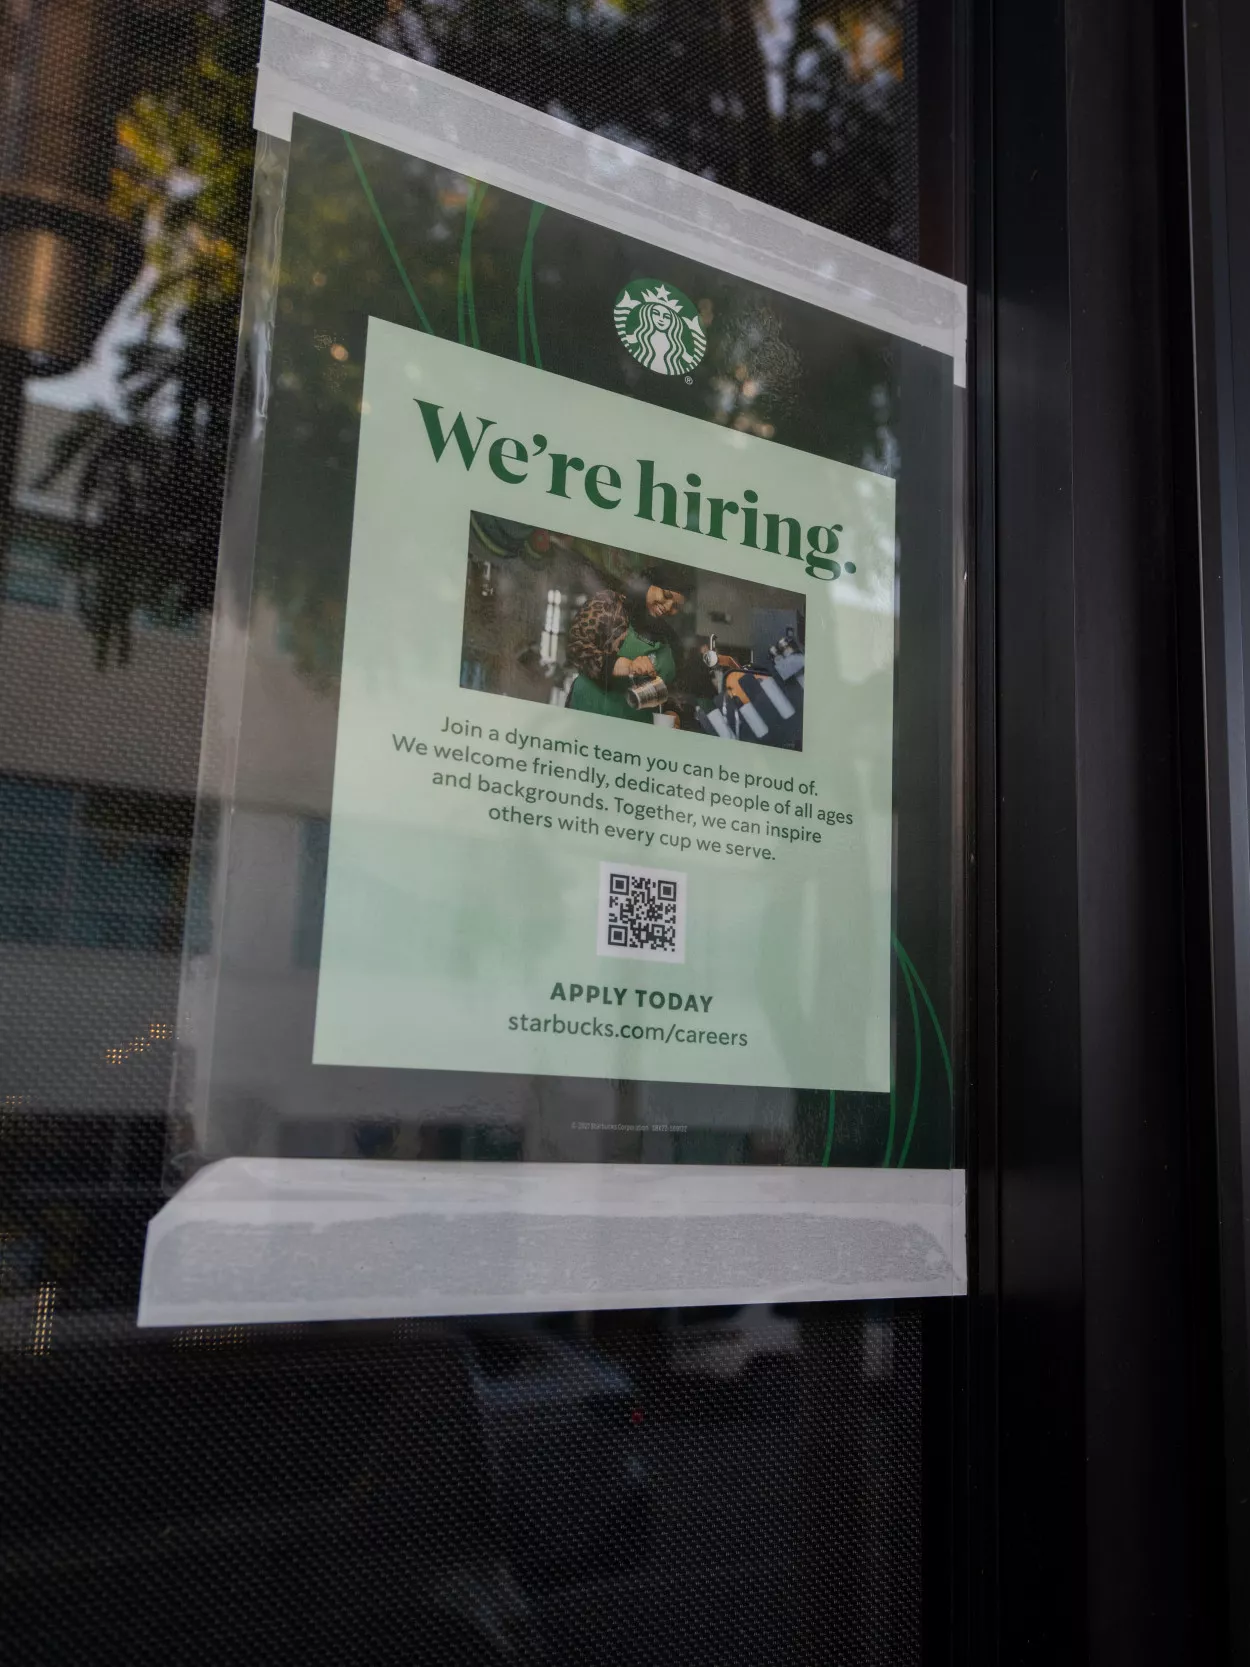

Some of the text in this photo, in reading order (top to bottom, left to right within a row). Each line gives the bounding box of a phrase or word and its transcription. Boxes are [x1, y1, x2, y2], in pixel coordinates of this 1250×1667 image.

[413, 398, 857, 581] We’re hiring.
[392, 734, 853, 826] We welcome friendly, dedicated people of all ages
[441, 716, 818, 796] Join a dynamic team you can be proud of.
[432, 771, 822, 844] and backgrounds. Together, we can inspire
[489, 806, 776, 861] others with every cup we serve.
[508, 1014, 748, 1047] starbucks.com/careers
[550, 982, 713, 1013] APPLY TODAY
